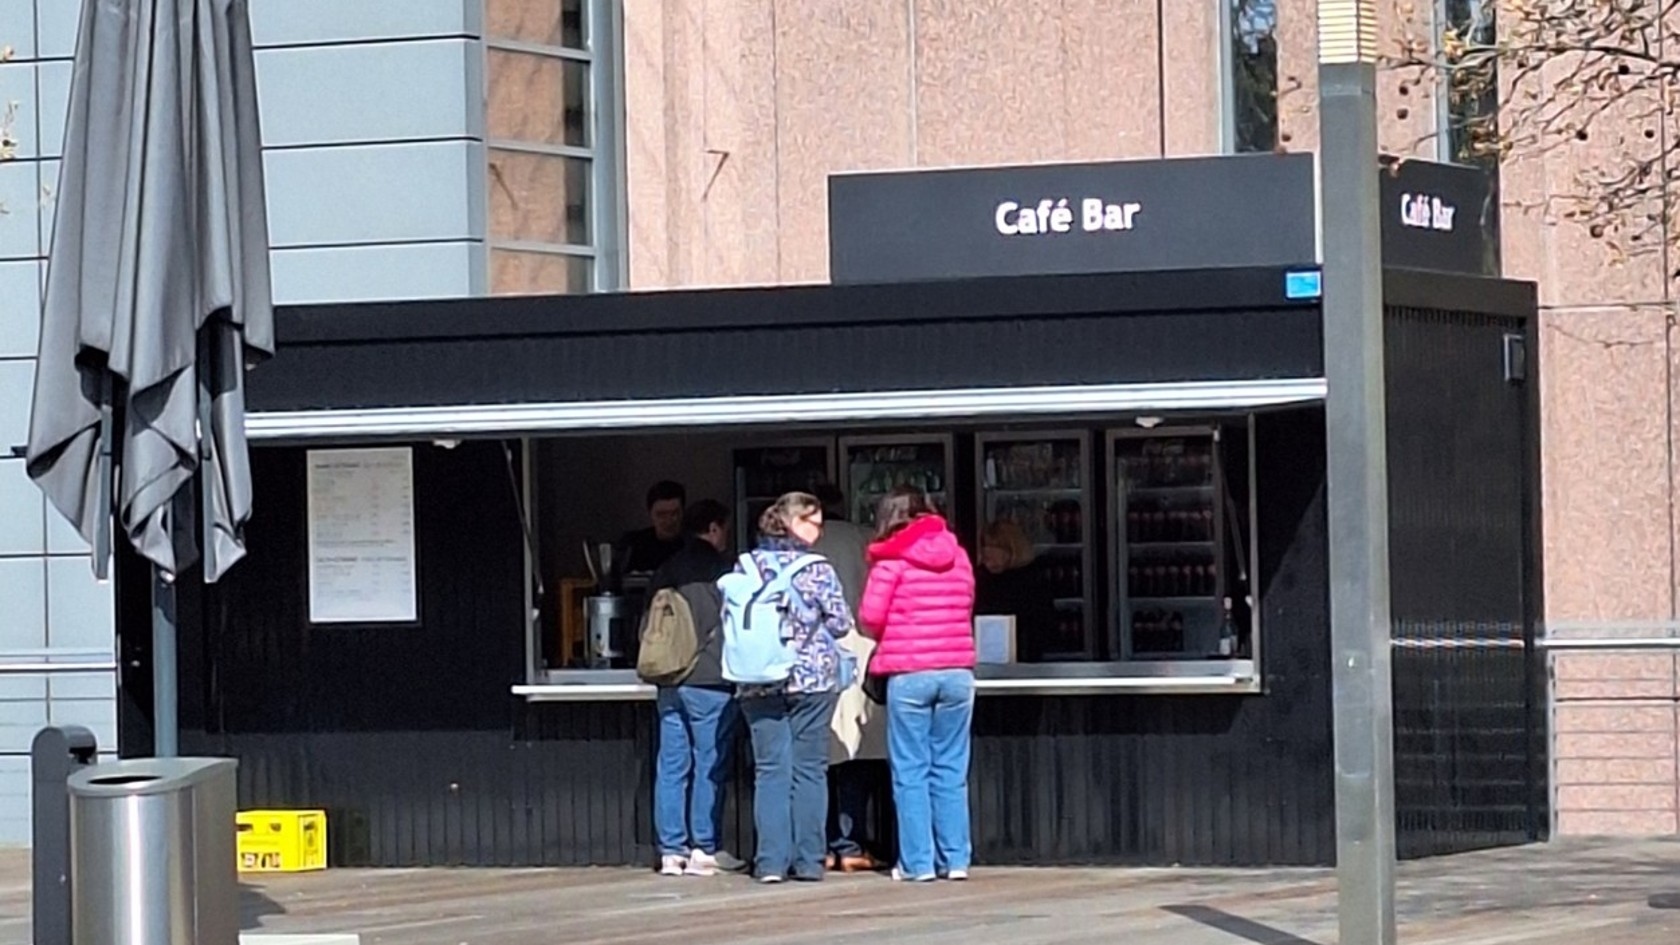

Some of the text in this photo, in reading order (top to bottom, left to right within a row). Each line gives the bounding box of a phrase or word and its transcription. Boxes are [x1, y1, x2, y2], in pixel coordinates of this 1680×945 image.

[995, 198, 1141, 235] Café Bar
[1401, 193, 1455, 231] Café Bar
